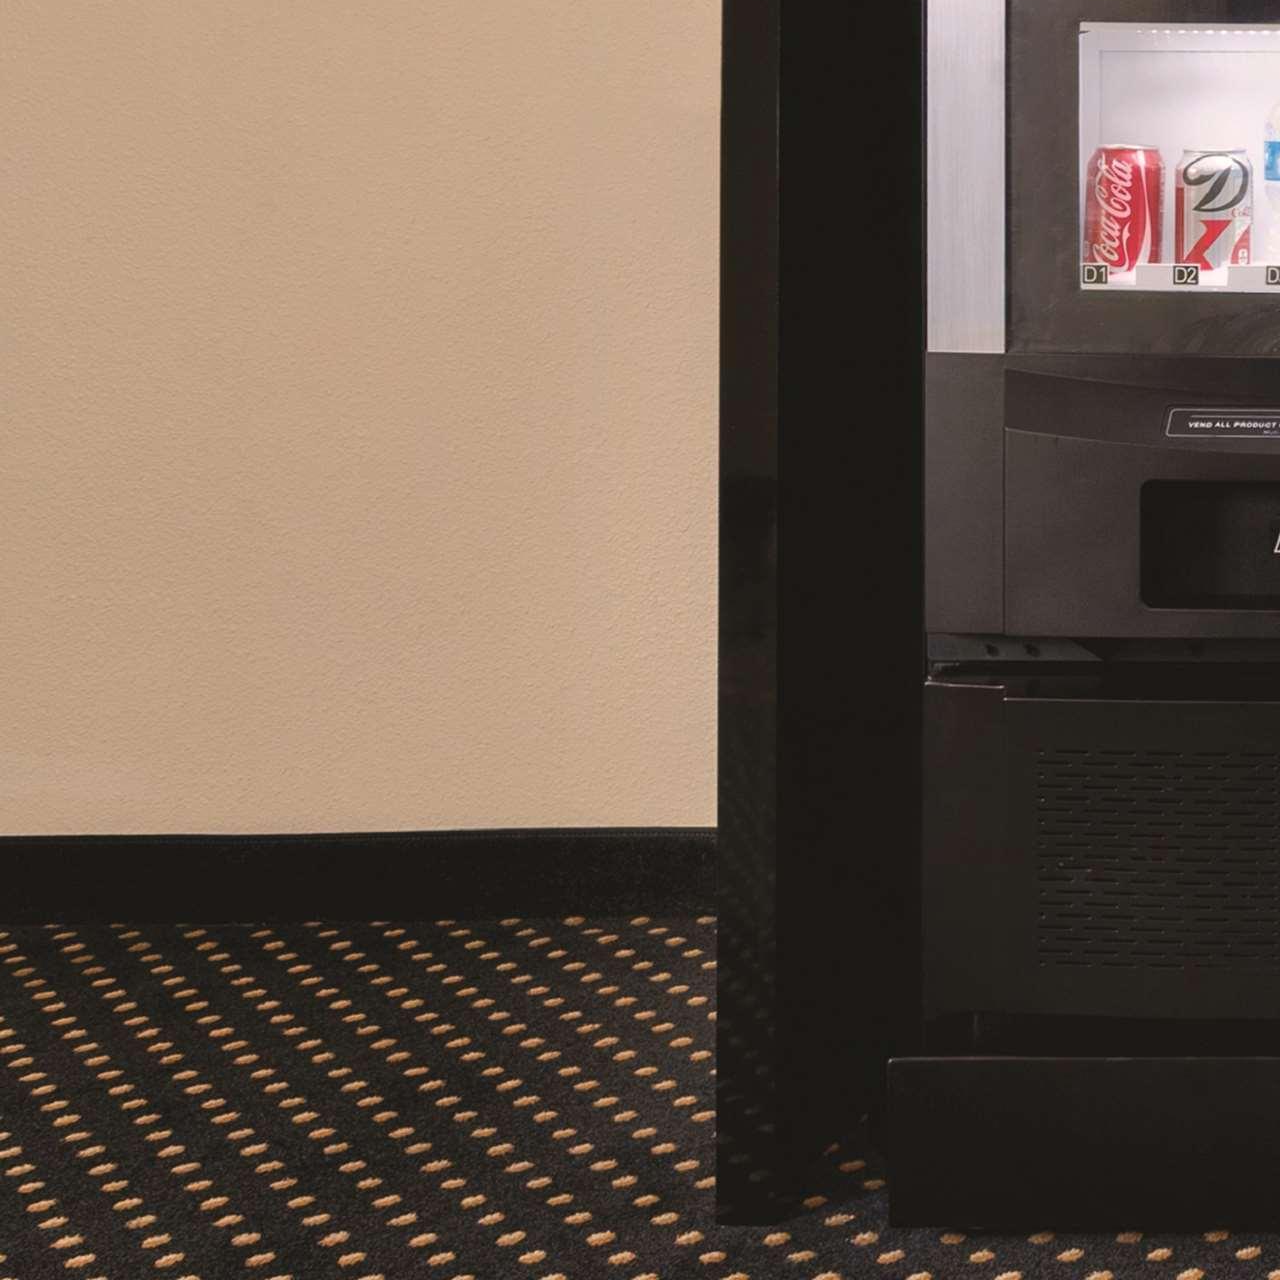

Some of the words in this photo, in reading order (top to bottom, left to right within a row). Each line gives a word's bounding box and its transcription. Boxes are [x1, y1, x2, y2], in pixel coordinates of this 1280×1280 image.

[1083, 267, 1107, 283] D1
[1175, 268, 1198, 283] D2
[1233, 421, 1276, 429] PRODUCT
